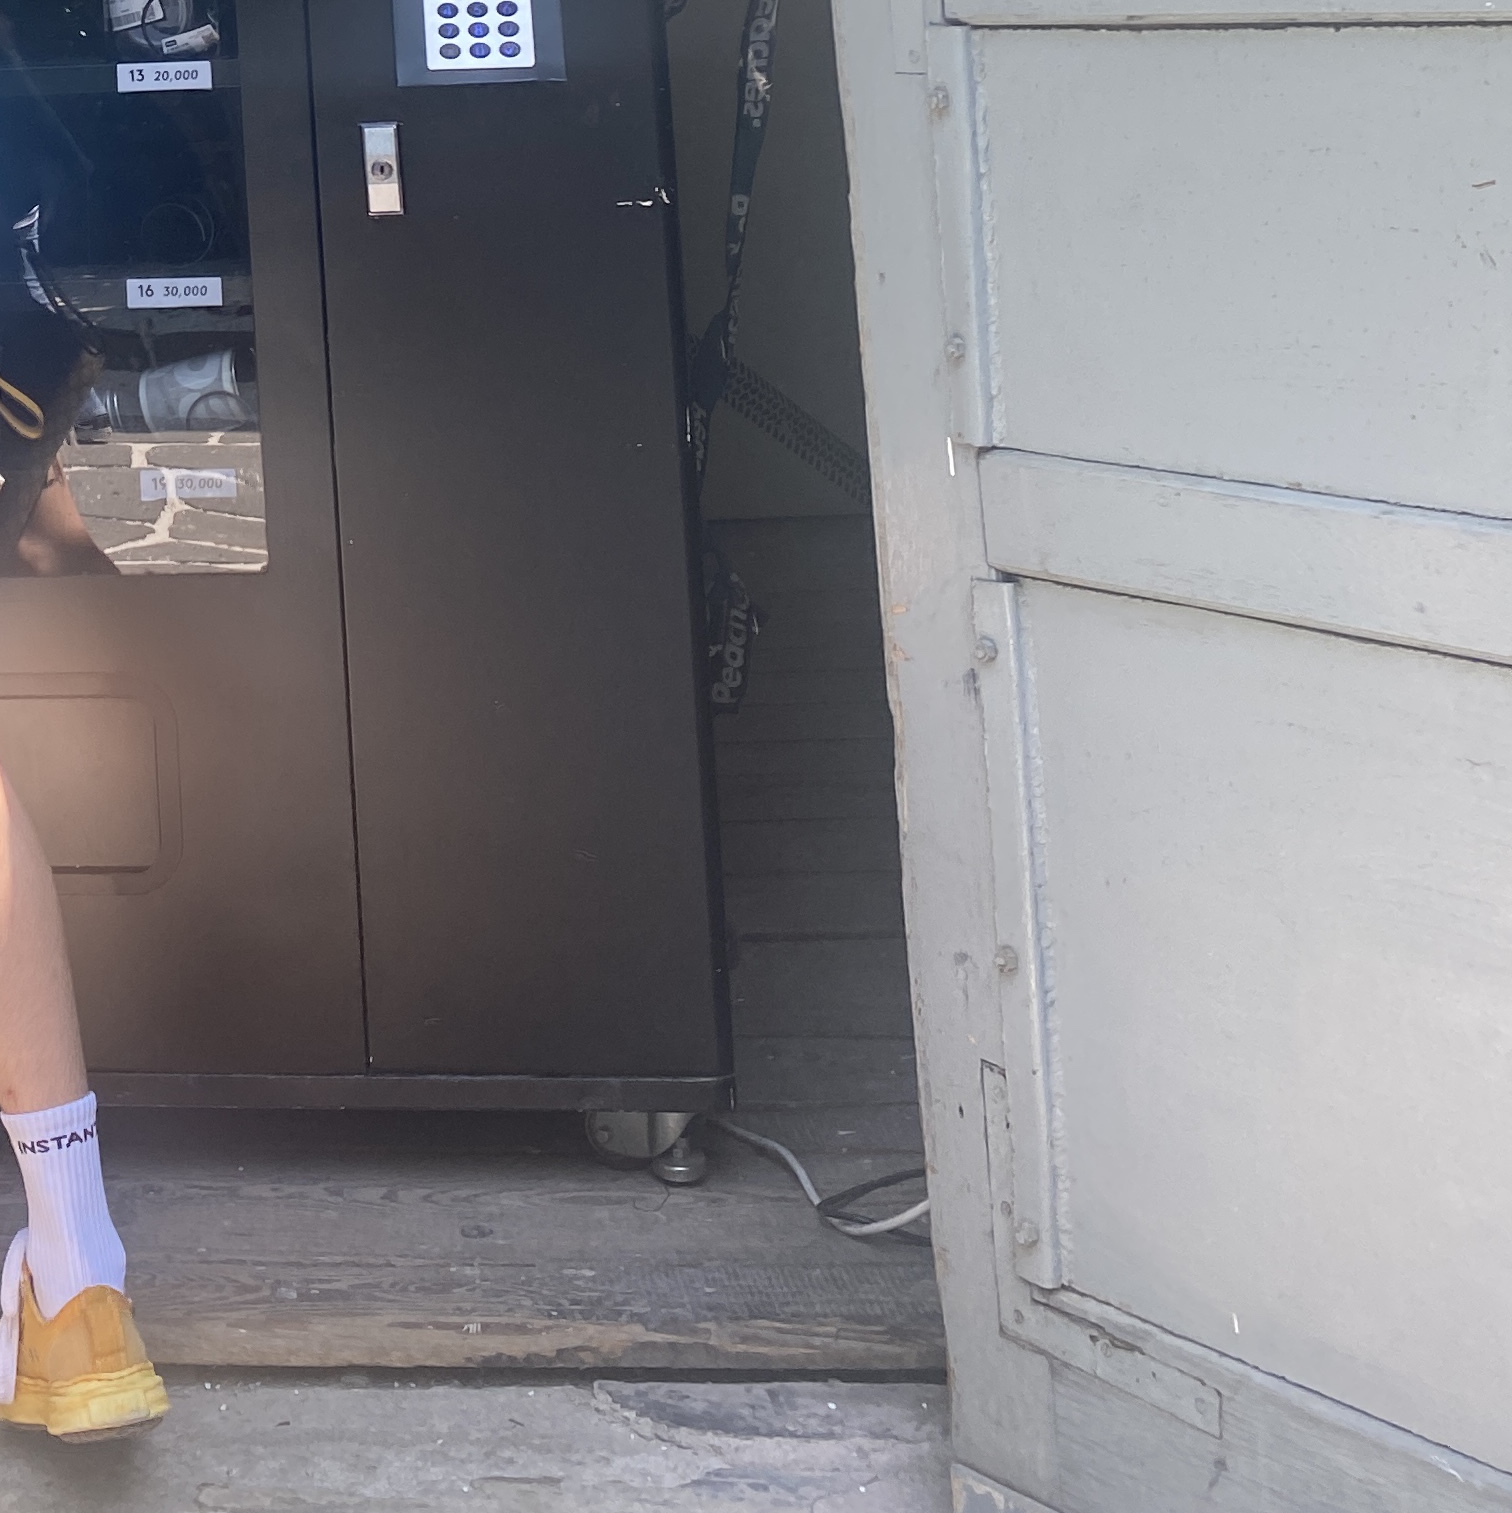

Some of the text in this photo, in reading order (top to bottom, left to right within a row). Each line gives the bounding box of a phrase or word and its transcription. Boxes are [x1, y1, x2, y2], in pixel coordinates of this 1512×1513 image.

[129, 69, 199, 83] 13 20,000
[138, 284, 208, 298] 16 30,000
[178, 477, 223, 491] 30,000
[17, 1121, 97, 1155] INSTAN
